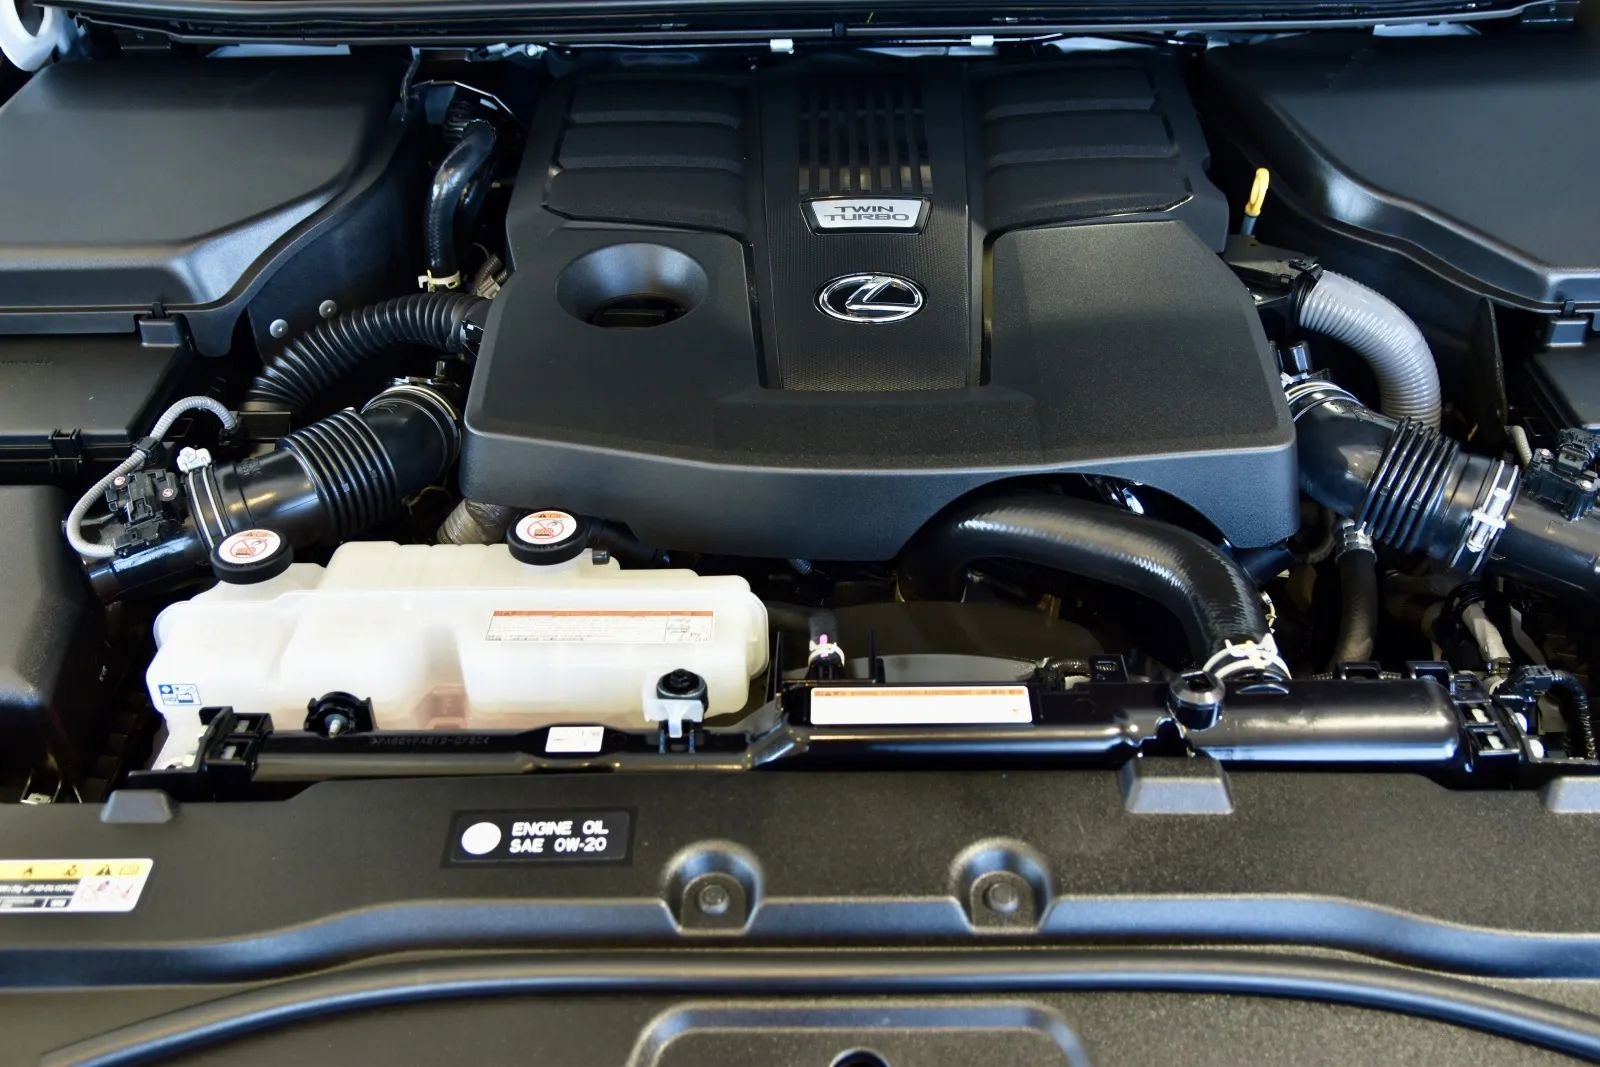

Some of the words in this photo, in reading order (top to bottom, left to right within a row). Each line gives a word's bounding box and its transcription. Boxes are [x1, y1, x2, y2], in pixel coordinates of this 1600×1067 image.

[824, 213, 910, 221] TURBO
[512, 821, 573, 836] ENGINE
[582, 820, 609, 834] OIL
[509, 839, 545, 853] SAE
[554, 837, 607, 852] 0W-20
